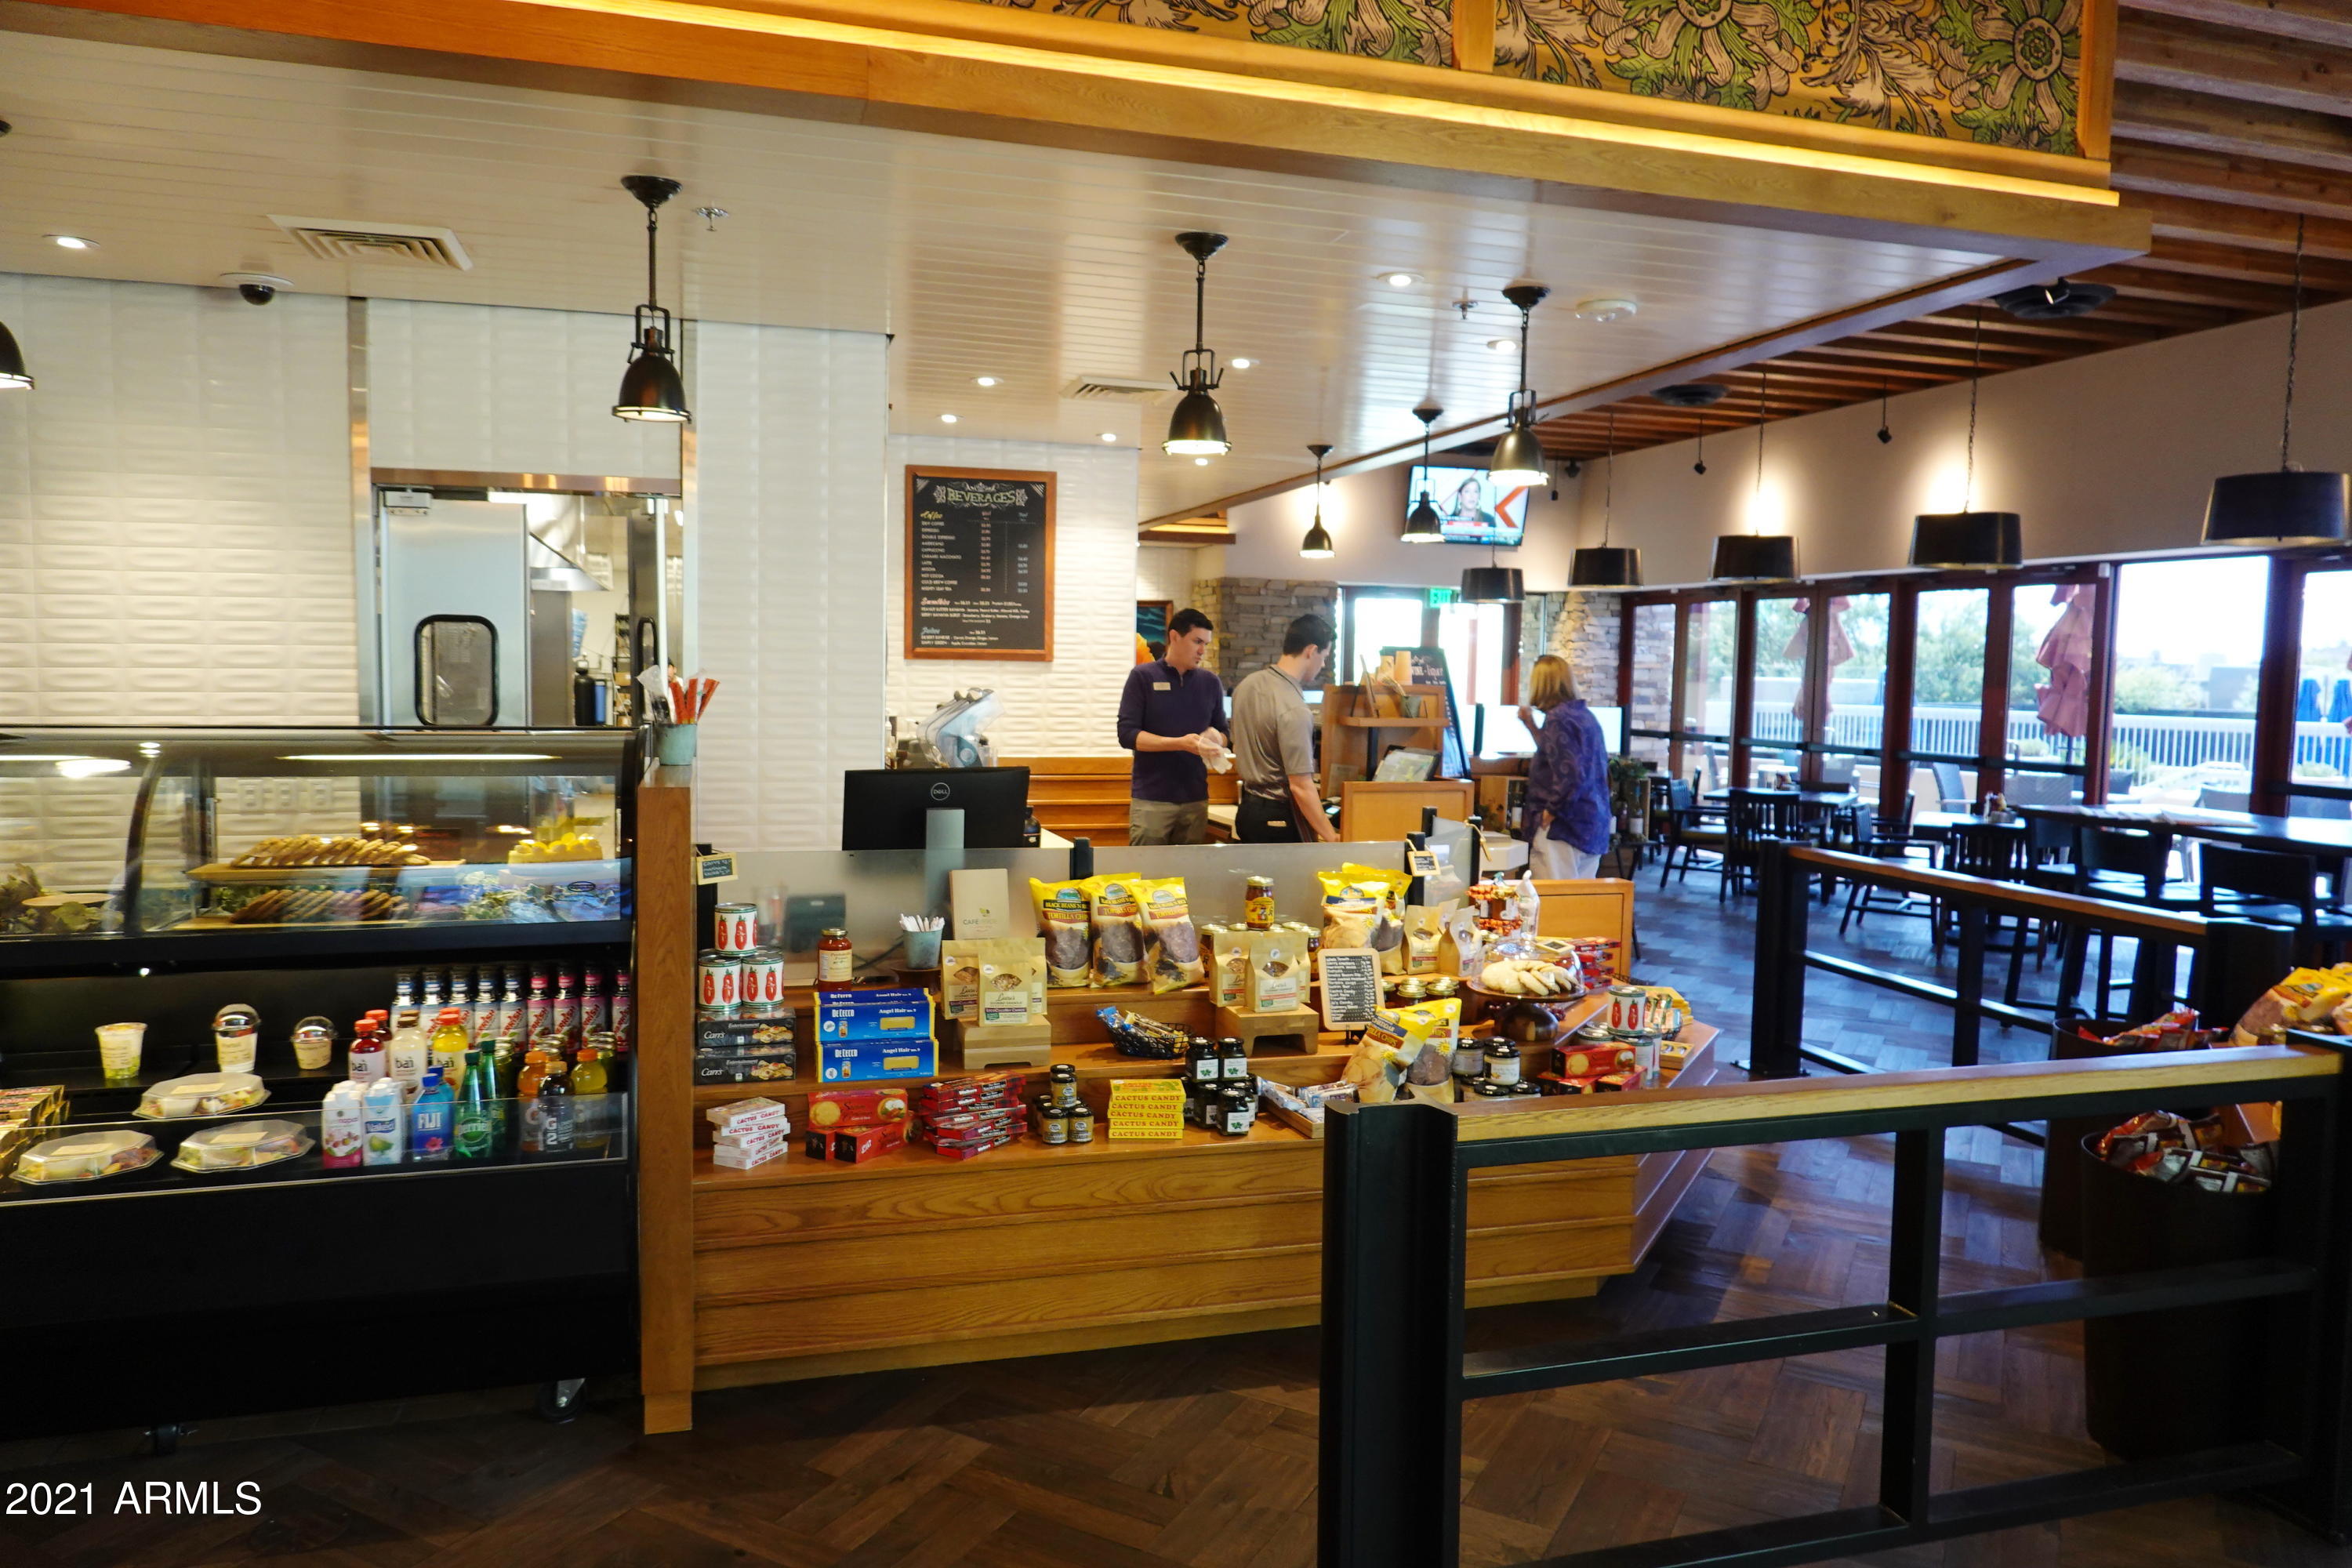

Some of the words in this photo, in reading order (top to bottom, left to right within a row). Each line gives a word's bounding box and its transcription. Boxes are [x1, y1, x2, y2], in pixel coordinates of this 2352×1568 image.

[946, 487, 1016, 503] BEVERAGES
[351, 1062, 368, 1072] bai
[395, 1057, 414, 1069] bai
[437, 1057, 455, 1069] bai
[417, 1112, 442, 1129] FIJI
[737, 1116, 757, 1124] CACTUS
[546, 1131, 558, 1145] 2
[746, 1135, 765, 1145] CACTUS
[768, 1129, 786, 1138] CANDY
[752, 1156, 767, 1166] CACTUS
[769, 1148, 784, 1158] CANDY
